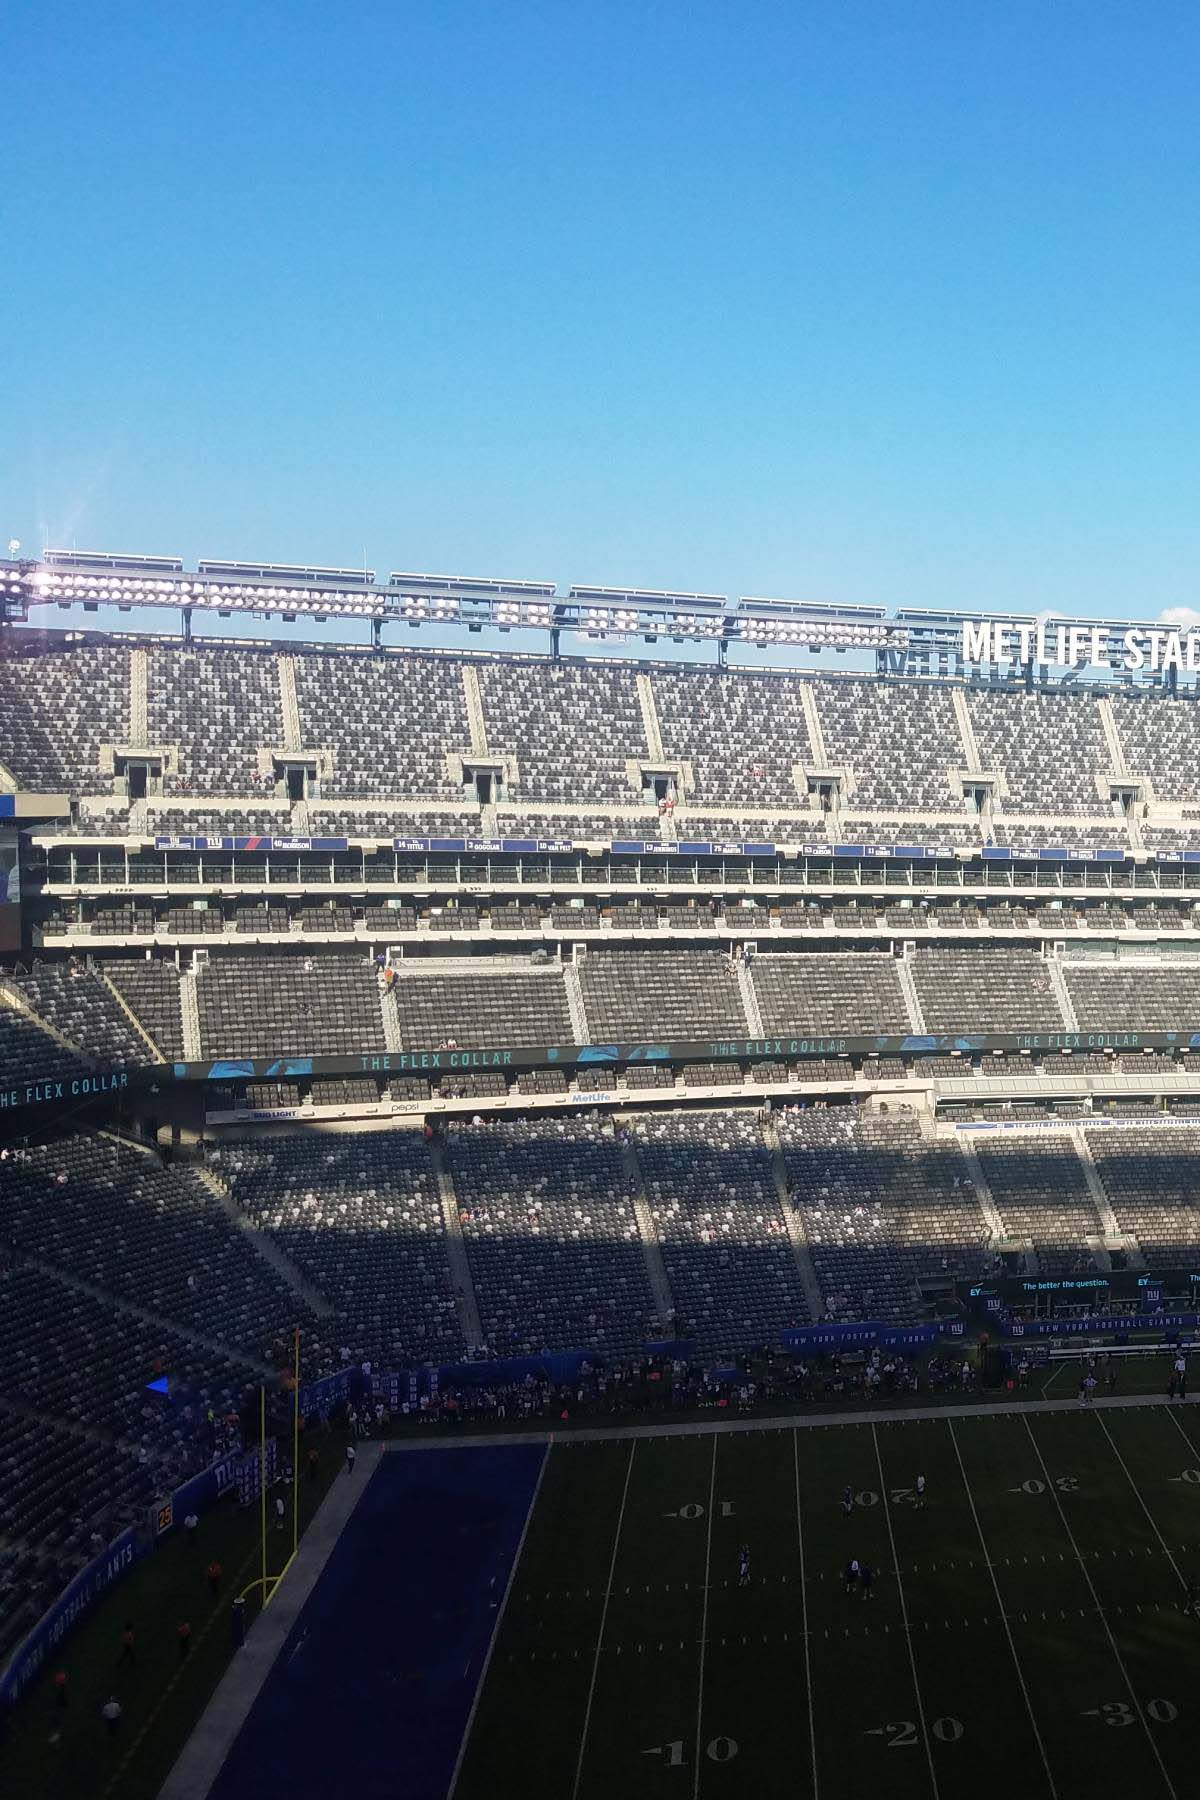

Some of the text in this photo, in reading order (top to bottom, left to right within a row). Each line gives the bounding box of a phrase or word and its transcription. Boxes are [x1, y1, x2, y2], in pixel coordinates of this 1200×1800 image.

[962, 620, 1111, 668] METLIFE
[709, 1040, 846, 1056] THE FLEX COLLAR
[1016, 1034, 1139, 1047] THE FLEX COLLAR
[361, 1052, 513, 1070] THE FLEX COLLAR
[26, 1083, 63, 1103] FLEX
[71, 1073, 128, 1095] COLLAR
[572, 1092, 610, 1102] MetLife
[272, 1110, 296, 1118] LIGHT
[392, 1102, 418, 1112] pepsi
[1023, 1282, 1037, 1290] The
[1038, 1282, 1061, 1290] better
[1076, 1279, 1110, 1288] question.
[1138, 1278, 1148, 1286] EY
[970, 1288, 982, 1296] EY
[1040, 1324, 1059, 1333] NEW
[1095, 1320, 1142, 1330] FOOTBALL
[1148, 1317, 1183, 1326] GIANTS
[158, 1505, 172, 1528] 25
[1100, 1697, 1179, 1727] 30
[884, 1716, 964, 1747] 20
[665, 1736, 738, 1767] 10
